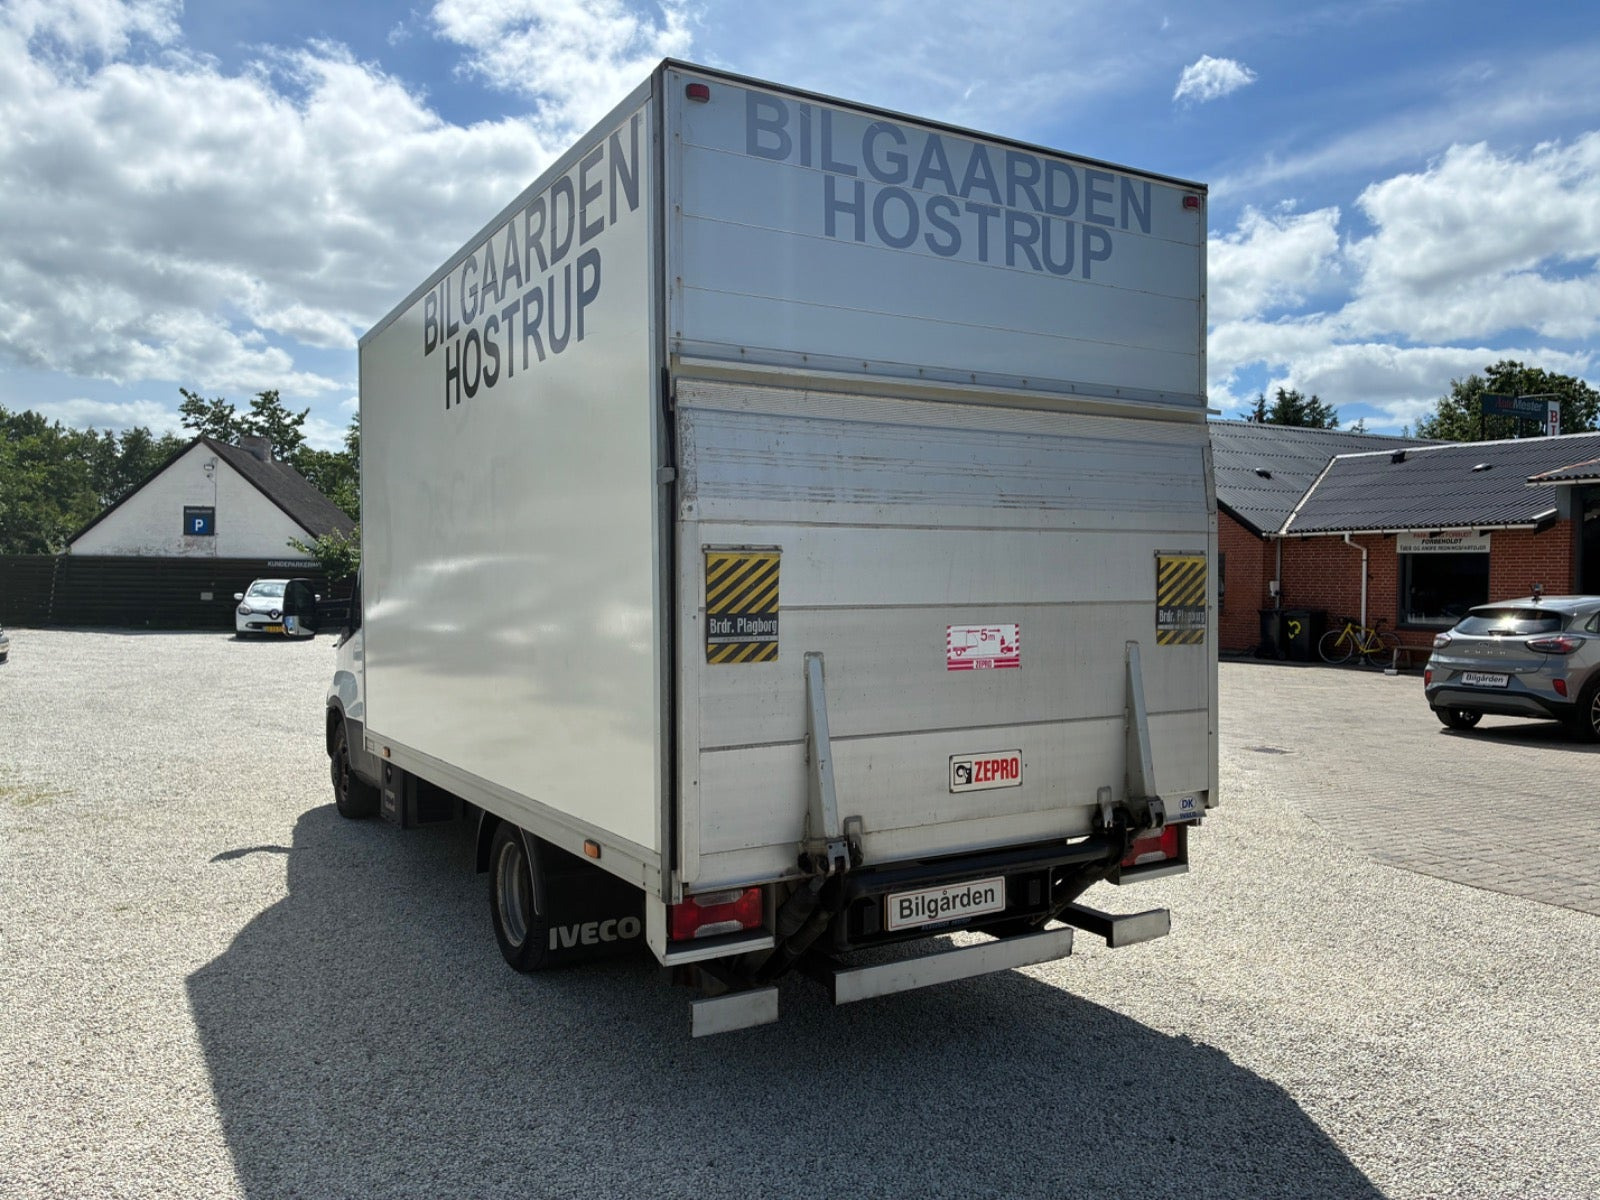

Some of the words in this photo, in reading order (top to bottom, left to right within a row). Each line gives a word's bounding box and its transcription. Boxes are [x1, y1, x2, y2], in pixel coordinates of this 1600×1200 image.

[746, 90, 1151, 234] BILGAARDEN
[424, 113, 640, 357] BILGAARDEN
[824, 175, 1112, 279] HOSTRUP
[446, 247, 601, 410] HOSTRUP
[195, 519, 204, 532] P
[709, 618, 735, 634] Brdr.
[737, 617, 777, 635] Plagborg
[1466, 673, 1504, 684] Bilgården
[974, 757, 1020, 783] ZEPRO
[1181, 799, 1194, 809] DK
[899, 887, 995, 919] Bilgården
[549, 916, 641, 950] IVECO
